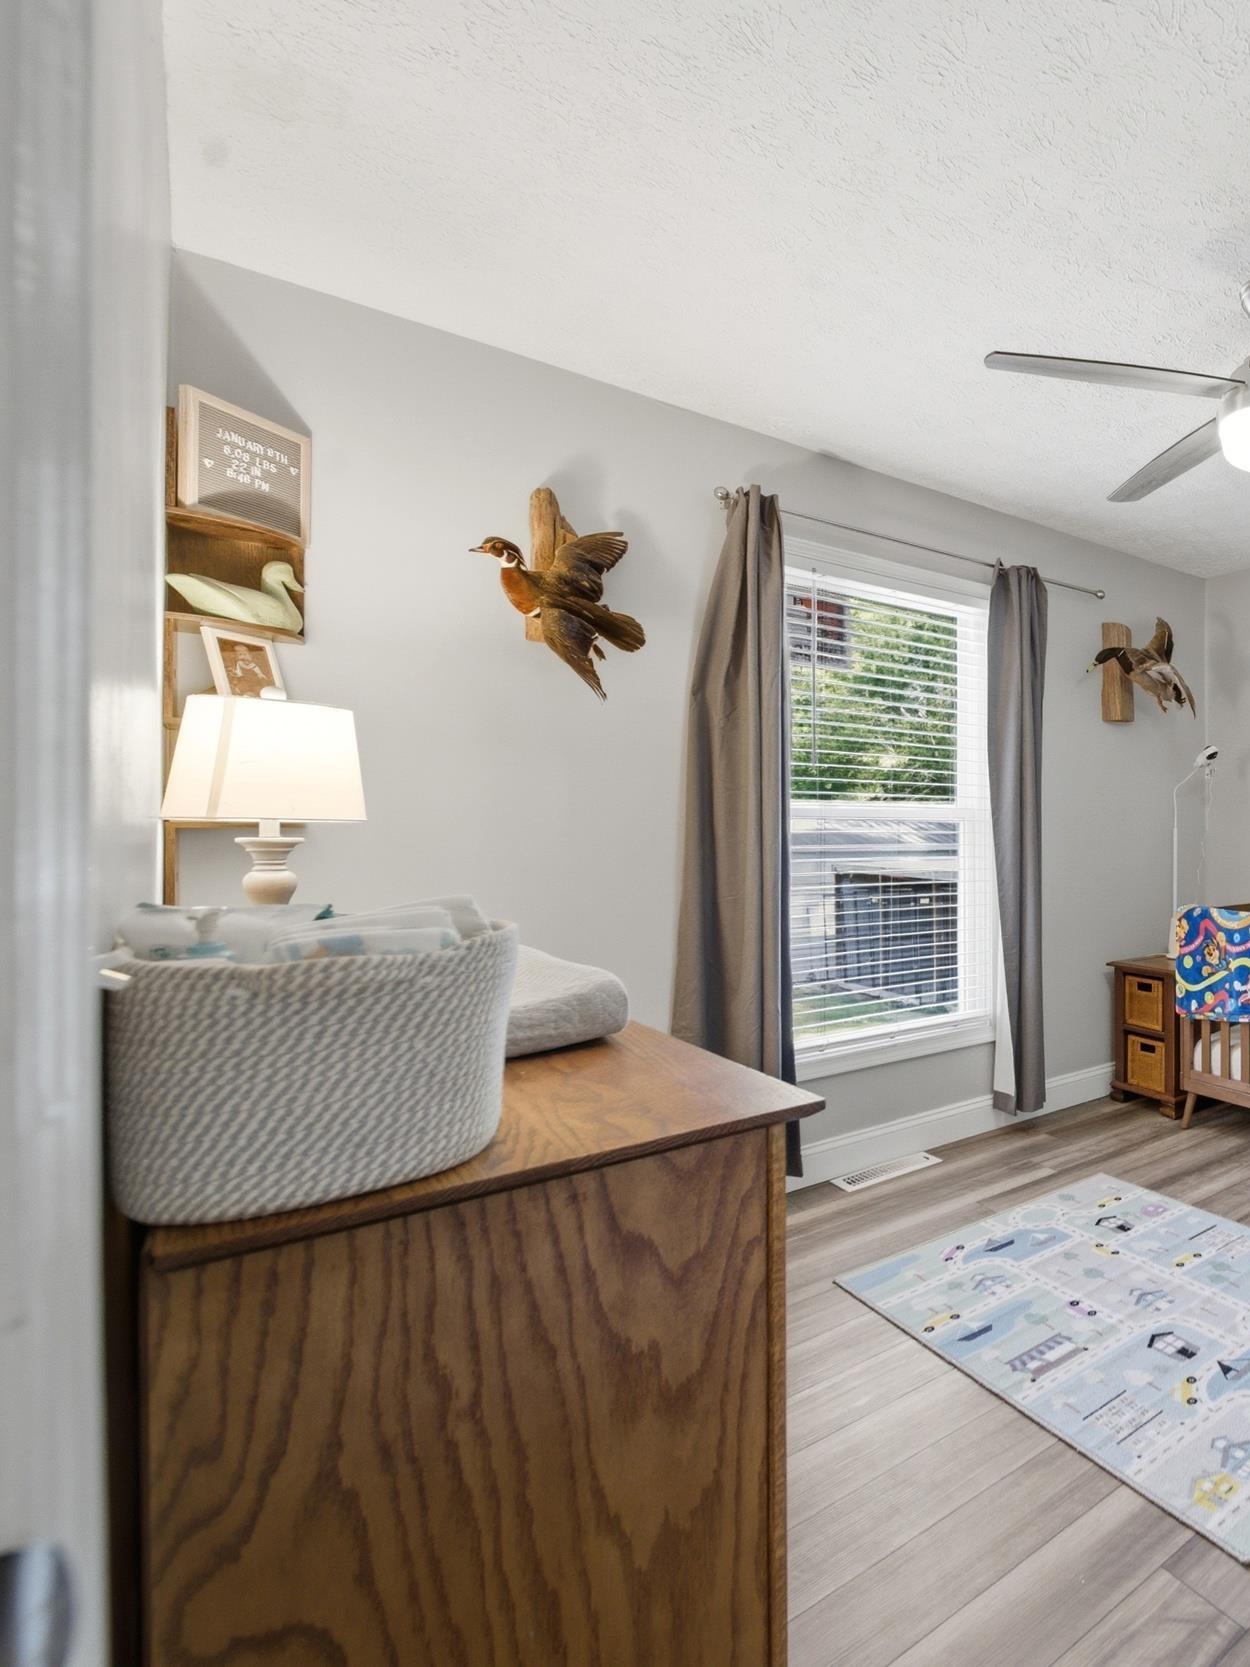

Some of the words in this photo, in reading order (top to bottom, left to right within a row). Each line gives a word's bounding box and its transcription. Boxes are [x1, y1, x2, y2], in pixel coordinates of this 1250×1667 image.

[215, 428, 264, 455] JANUARY
[231, 460, 247, 474] 22
[251, 465, 261, 477] IN
[256, 457, 277, 473] LBS
[254, 478, 270, 493] PM
